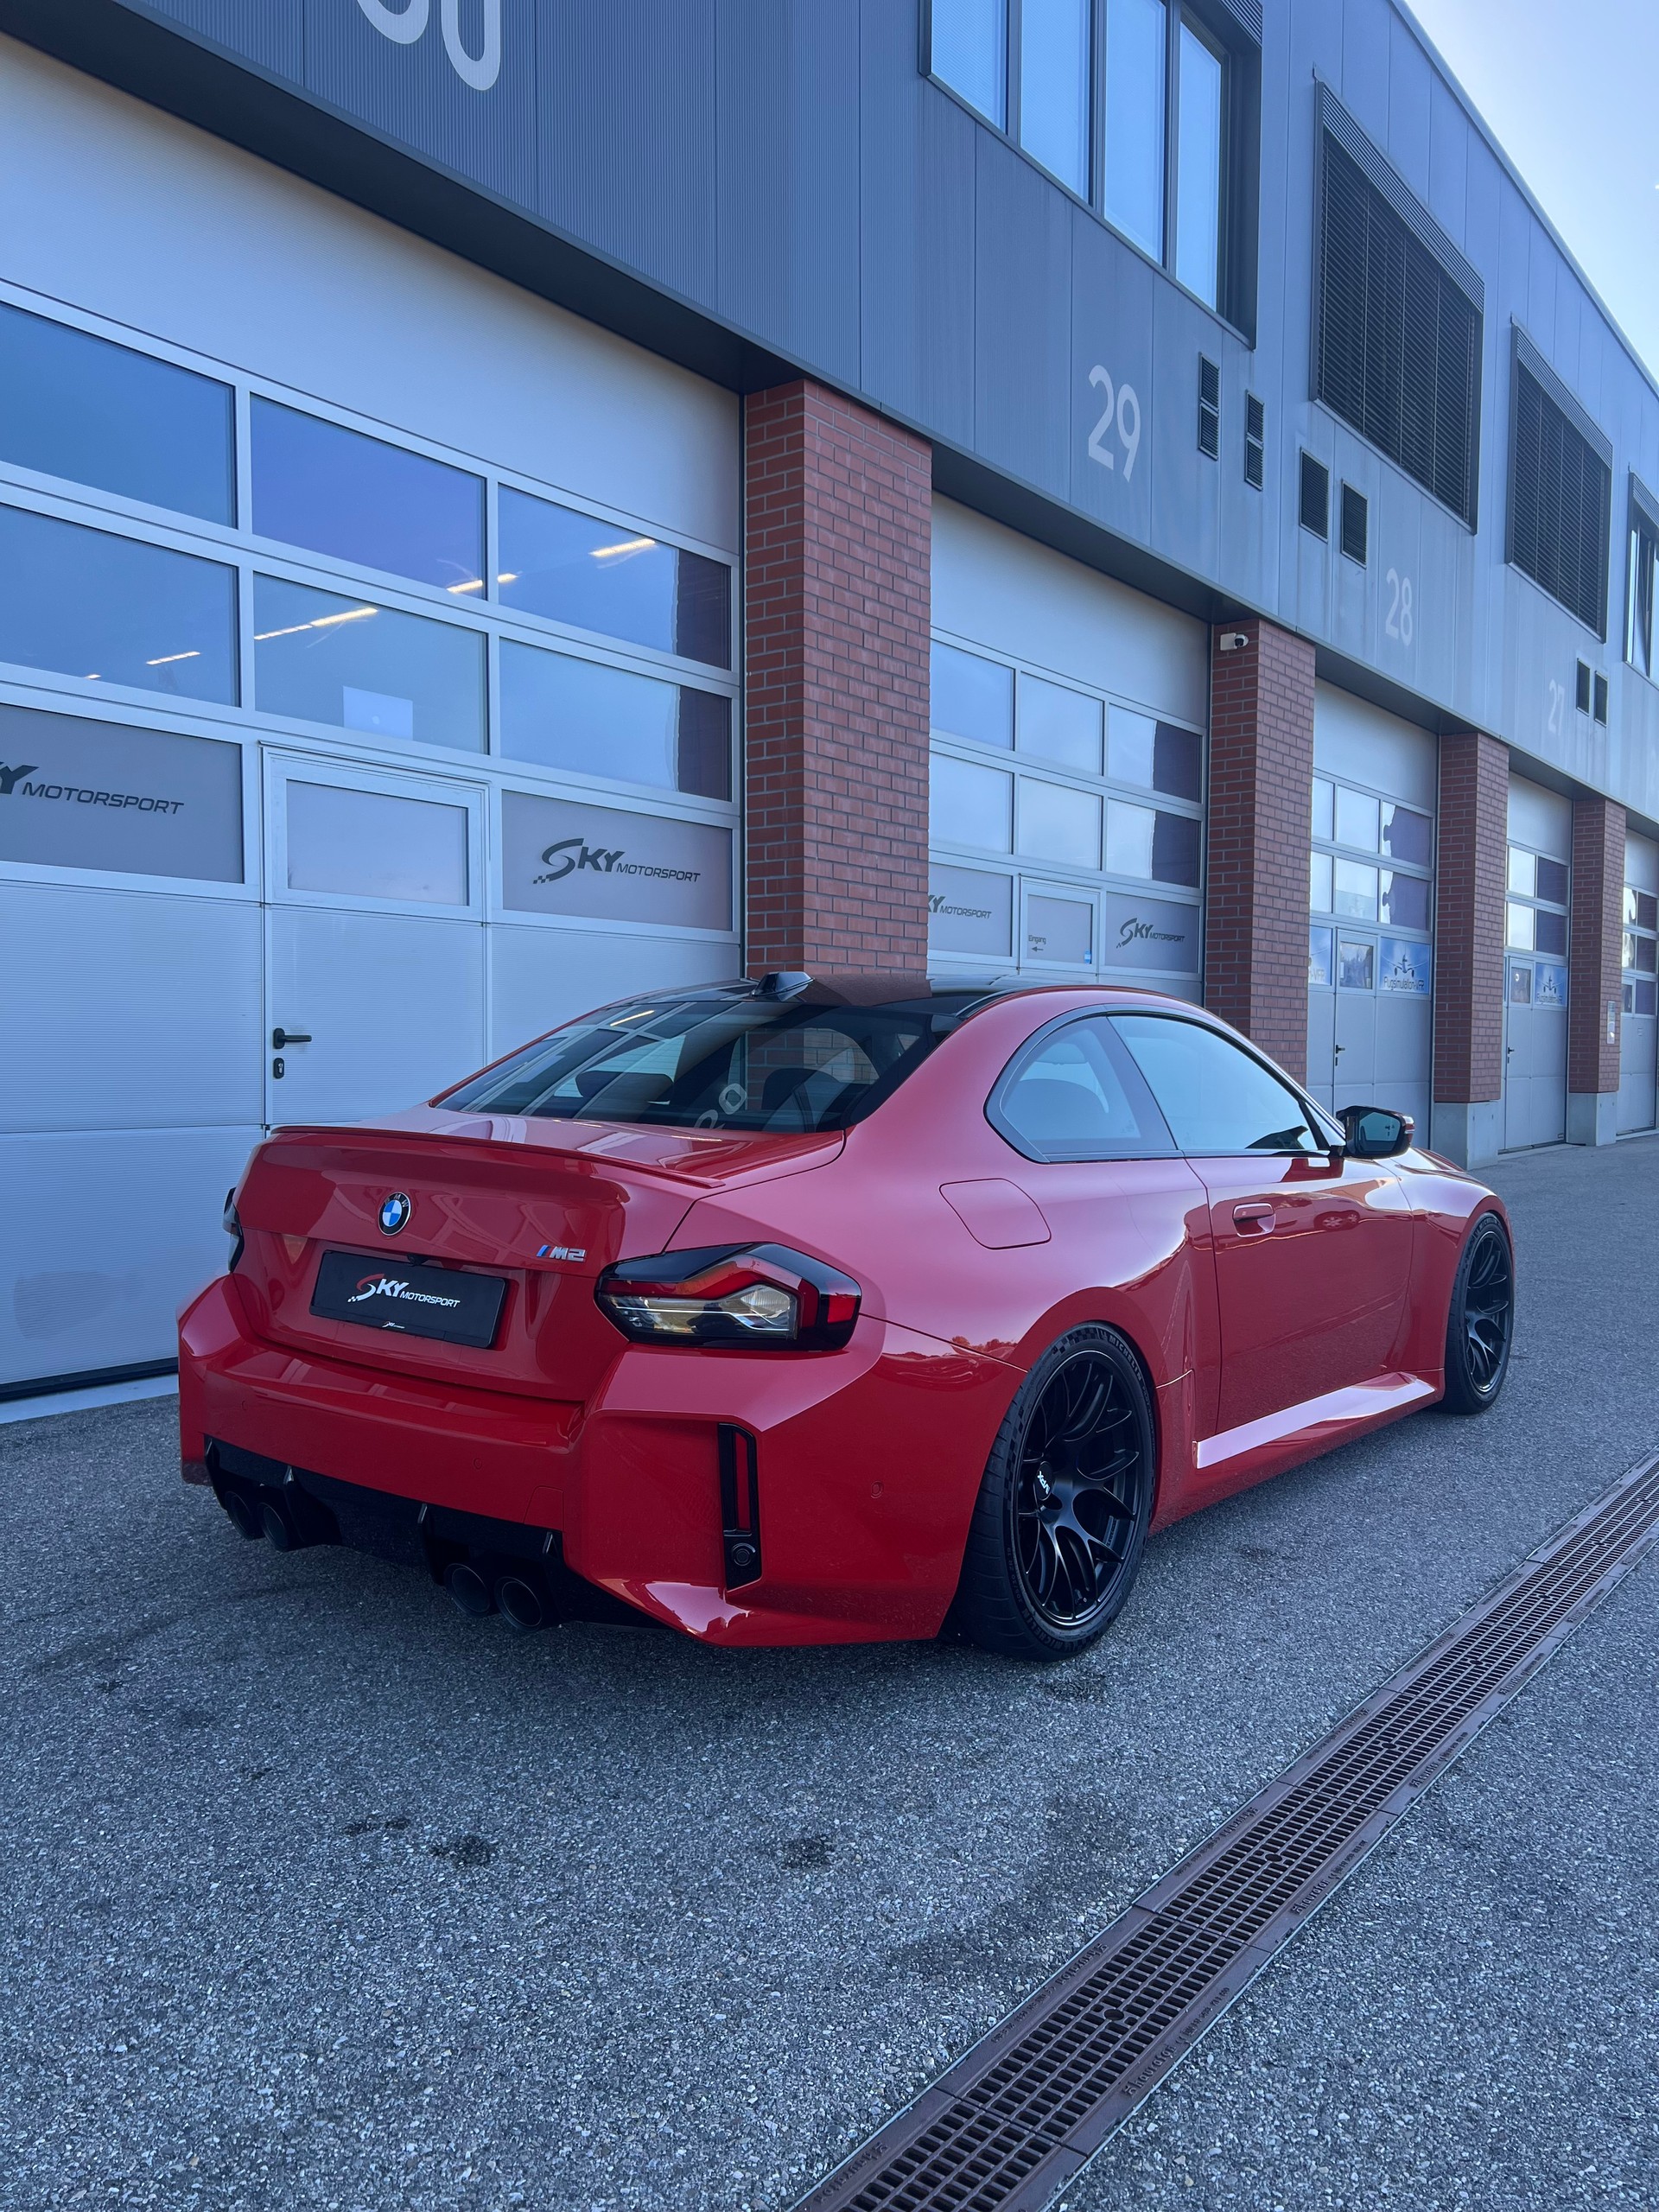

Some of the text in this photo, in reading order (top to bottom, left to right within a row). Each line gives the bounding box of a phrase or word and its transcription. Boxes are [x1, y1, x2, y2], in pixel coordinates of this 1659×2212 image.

[1088, 365, 1141, 483] 29
[1385, 567, 1413, 647] 28
[1548, 678, 1566, 737] 27
[22, 781, 185, 815] MOTORSPORT
[533, 837, 702, 885] SKY MOTORSPORT
[939, 905, 992, 919] MOTORSPORT
[1028, 934, 1046, 945] Eingang
[1116, 918, 1185, 949] SKY MOTORSPORT
[549, 1245, 587, 1262] M2
[347, 1273, 461, 1307] SKY MOTORSPORT
[1108, 1333, 1142, 1382] MICHELIN
